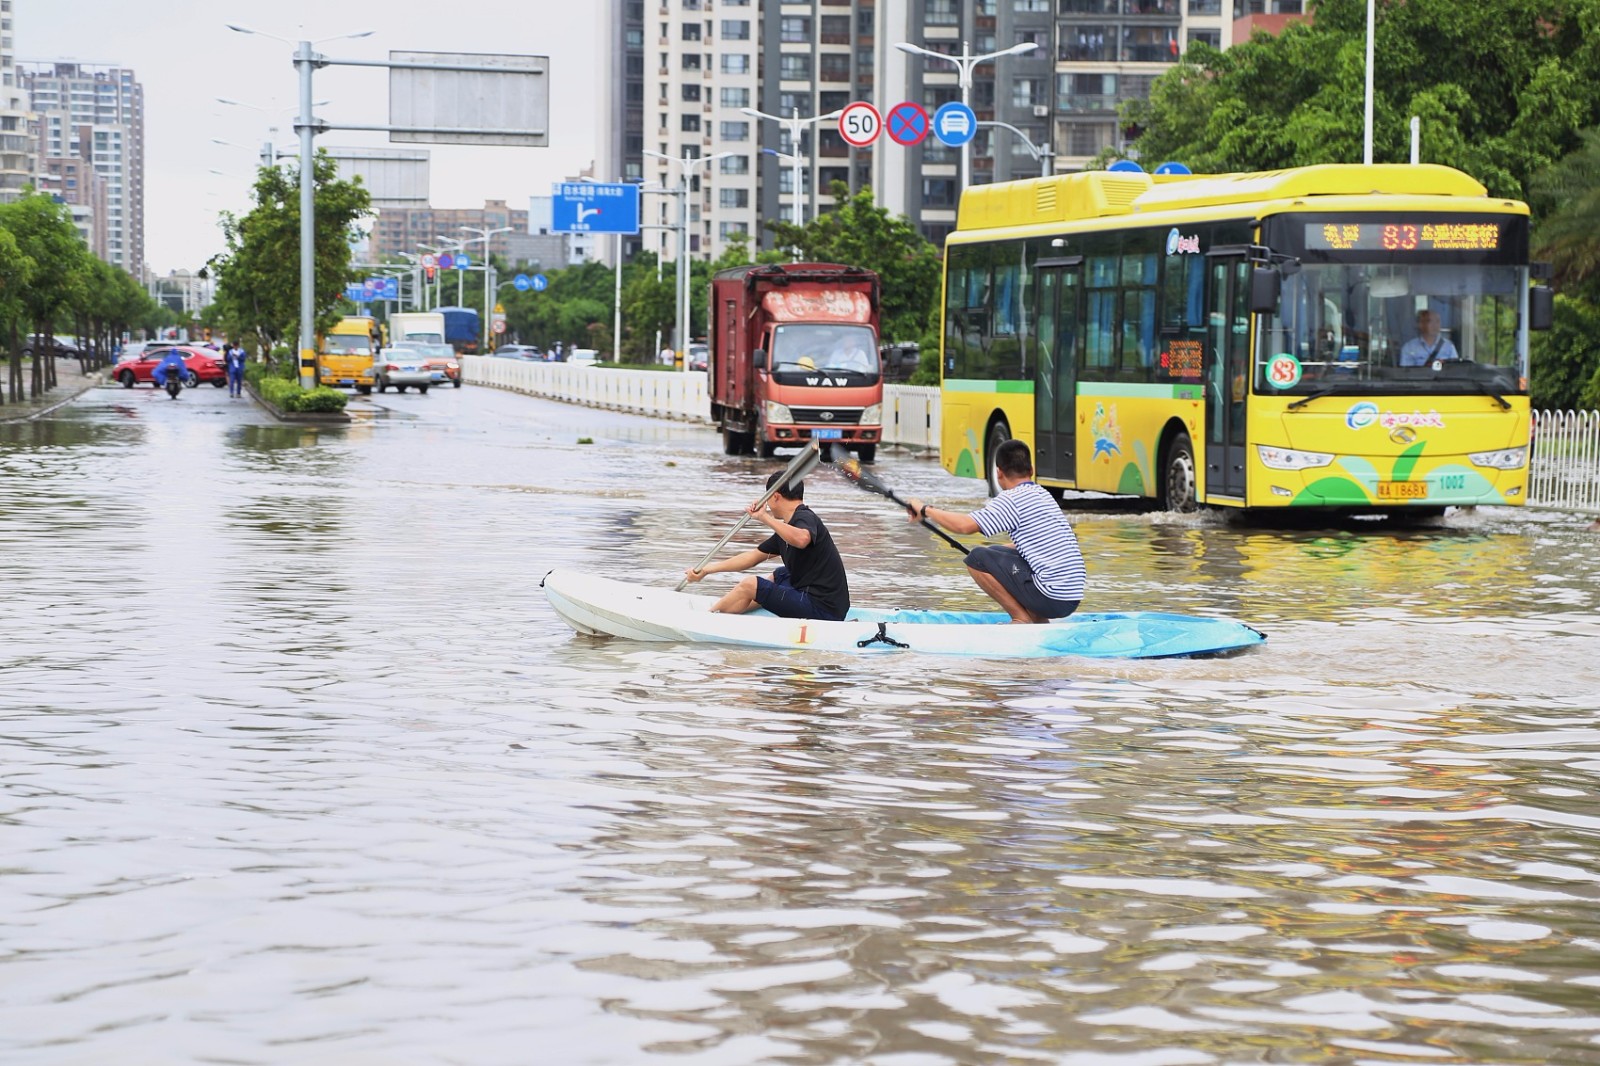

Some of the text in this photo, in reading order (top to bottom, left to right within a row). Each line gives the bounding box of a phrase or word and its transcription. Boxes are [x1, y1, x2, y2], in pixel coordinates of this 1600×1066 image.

[848, 115, 873, 134] 50
[1272, 359, 1295, 382] 83
[806, 377, 848, 387] WAW
[1440, 475, 1465, 490] 1002
[799, 625, 808, 643] 1
